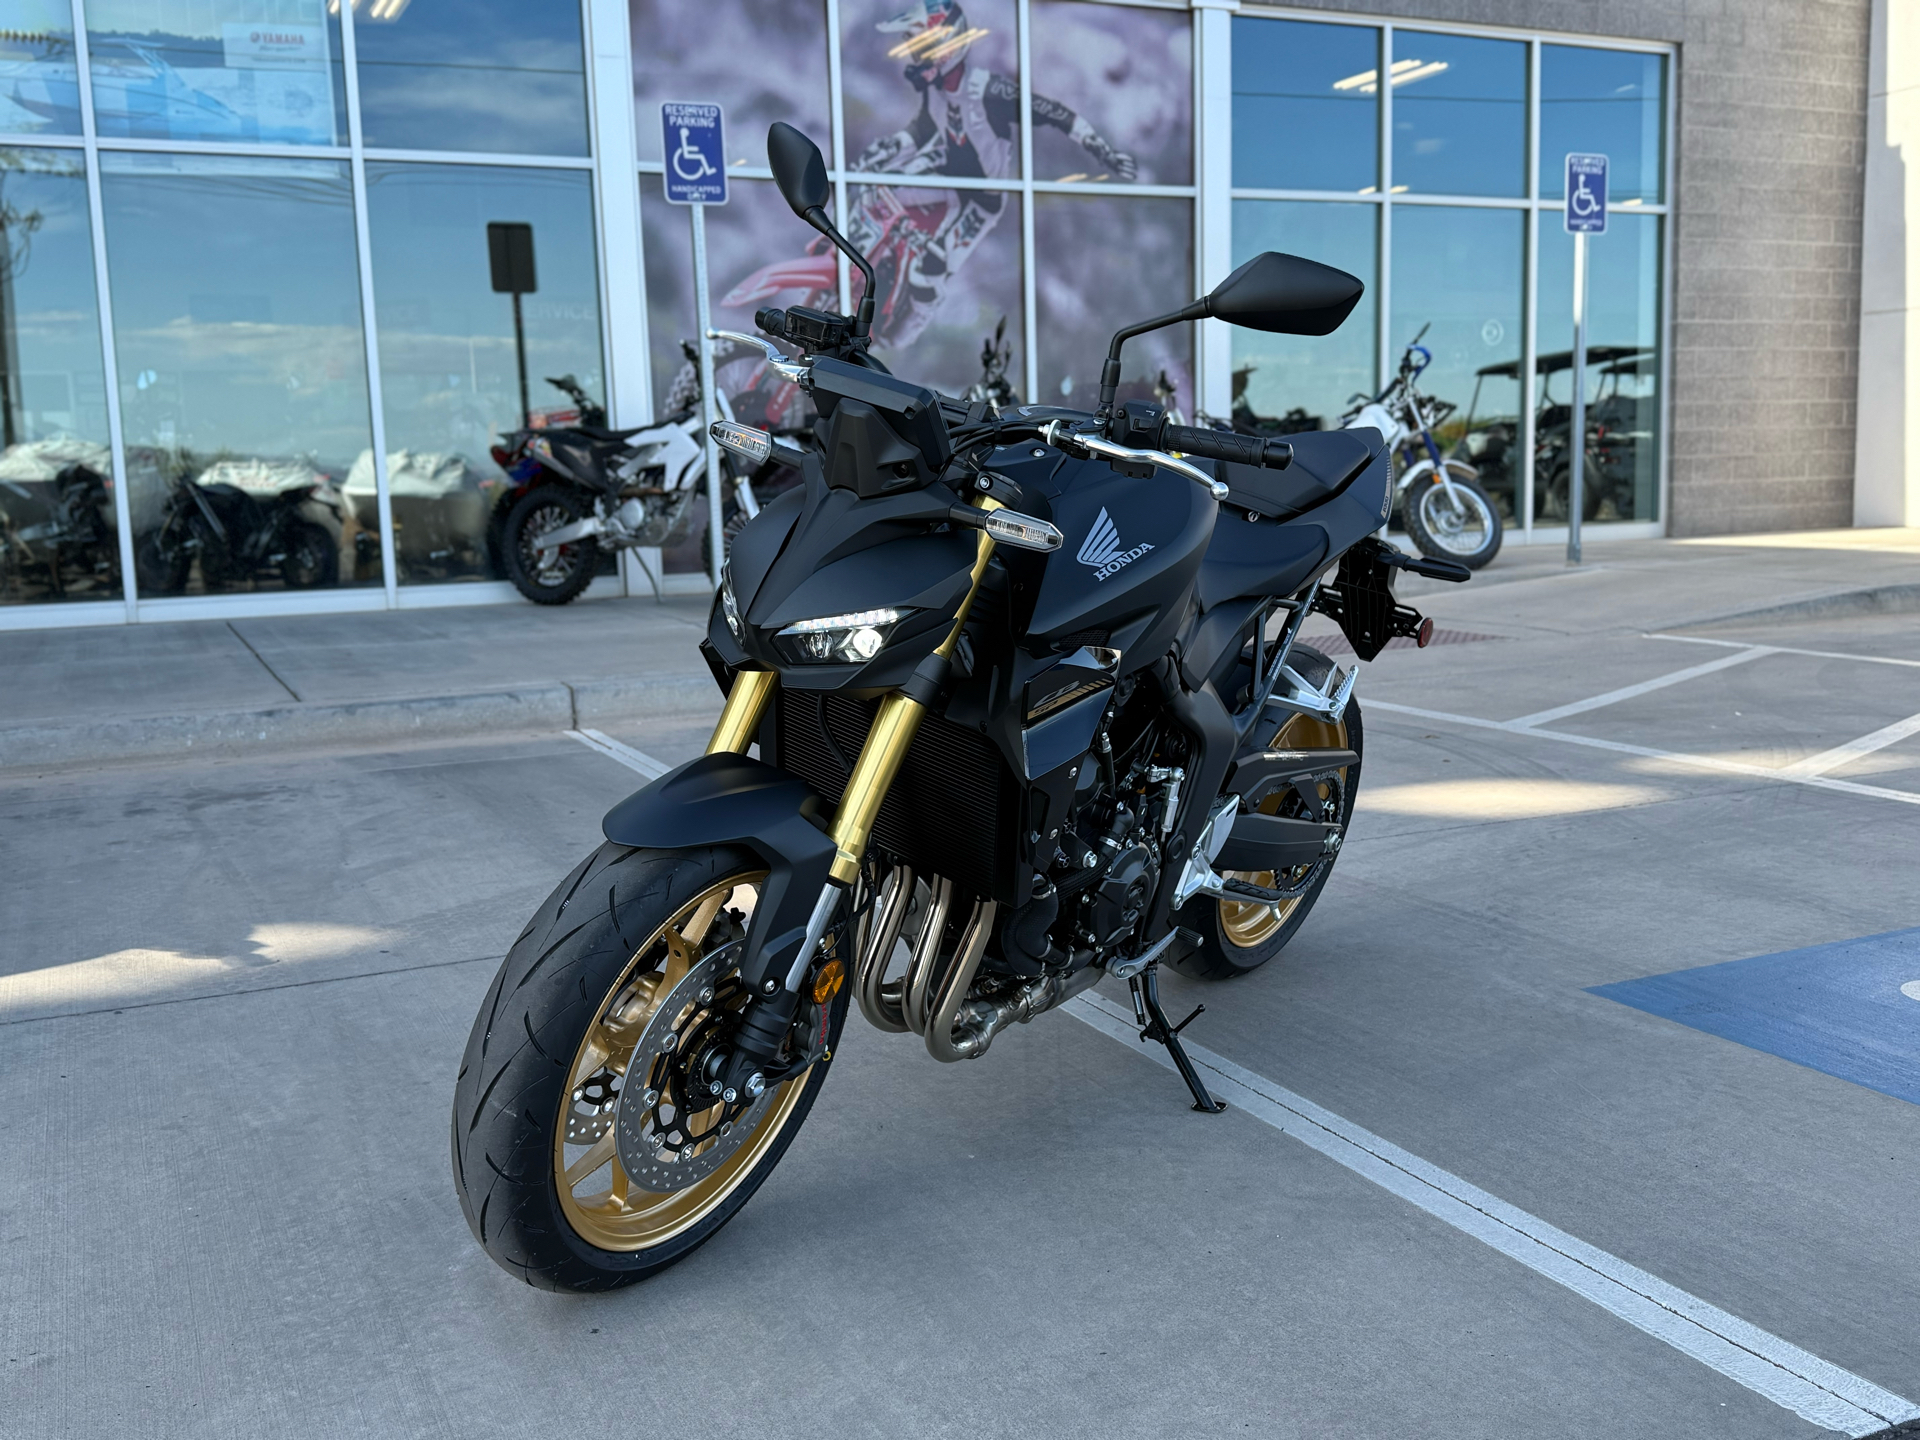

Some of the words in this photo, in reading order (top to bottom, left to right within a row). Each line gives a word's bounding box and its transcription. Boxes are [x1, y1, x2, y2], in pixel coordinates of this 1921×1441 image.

[261, 32, 305, 45] YAMAHA
[664, 104, 719, 118] RESERVED
[669, 115, 715, 128] PARKING
[1092, 542, 1155, 582] HONDA
